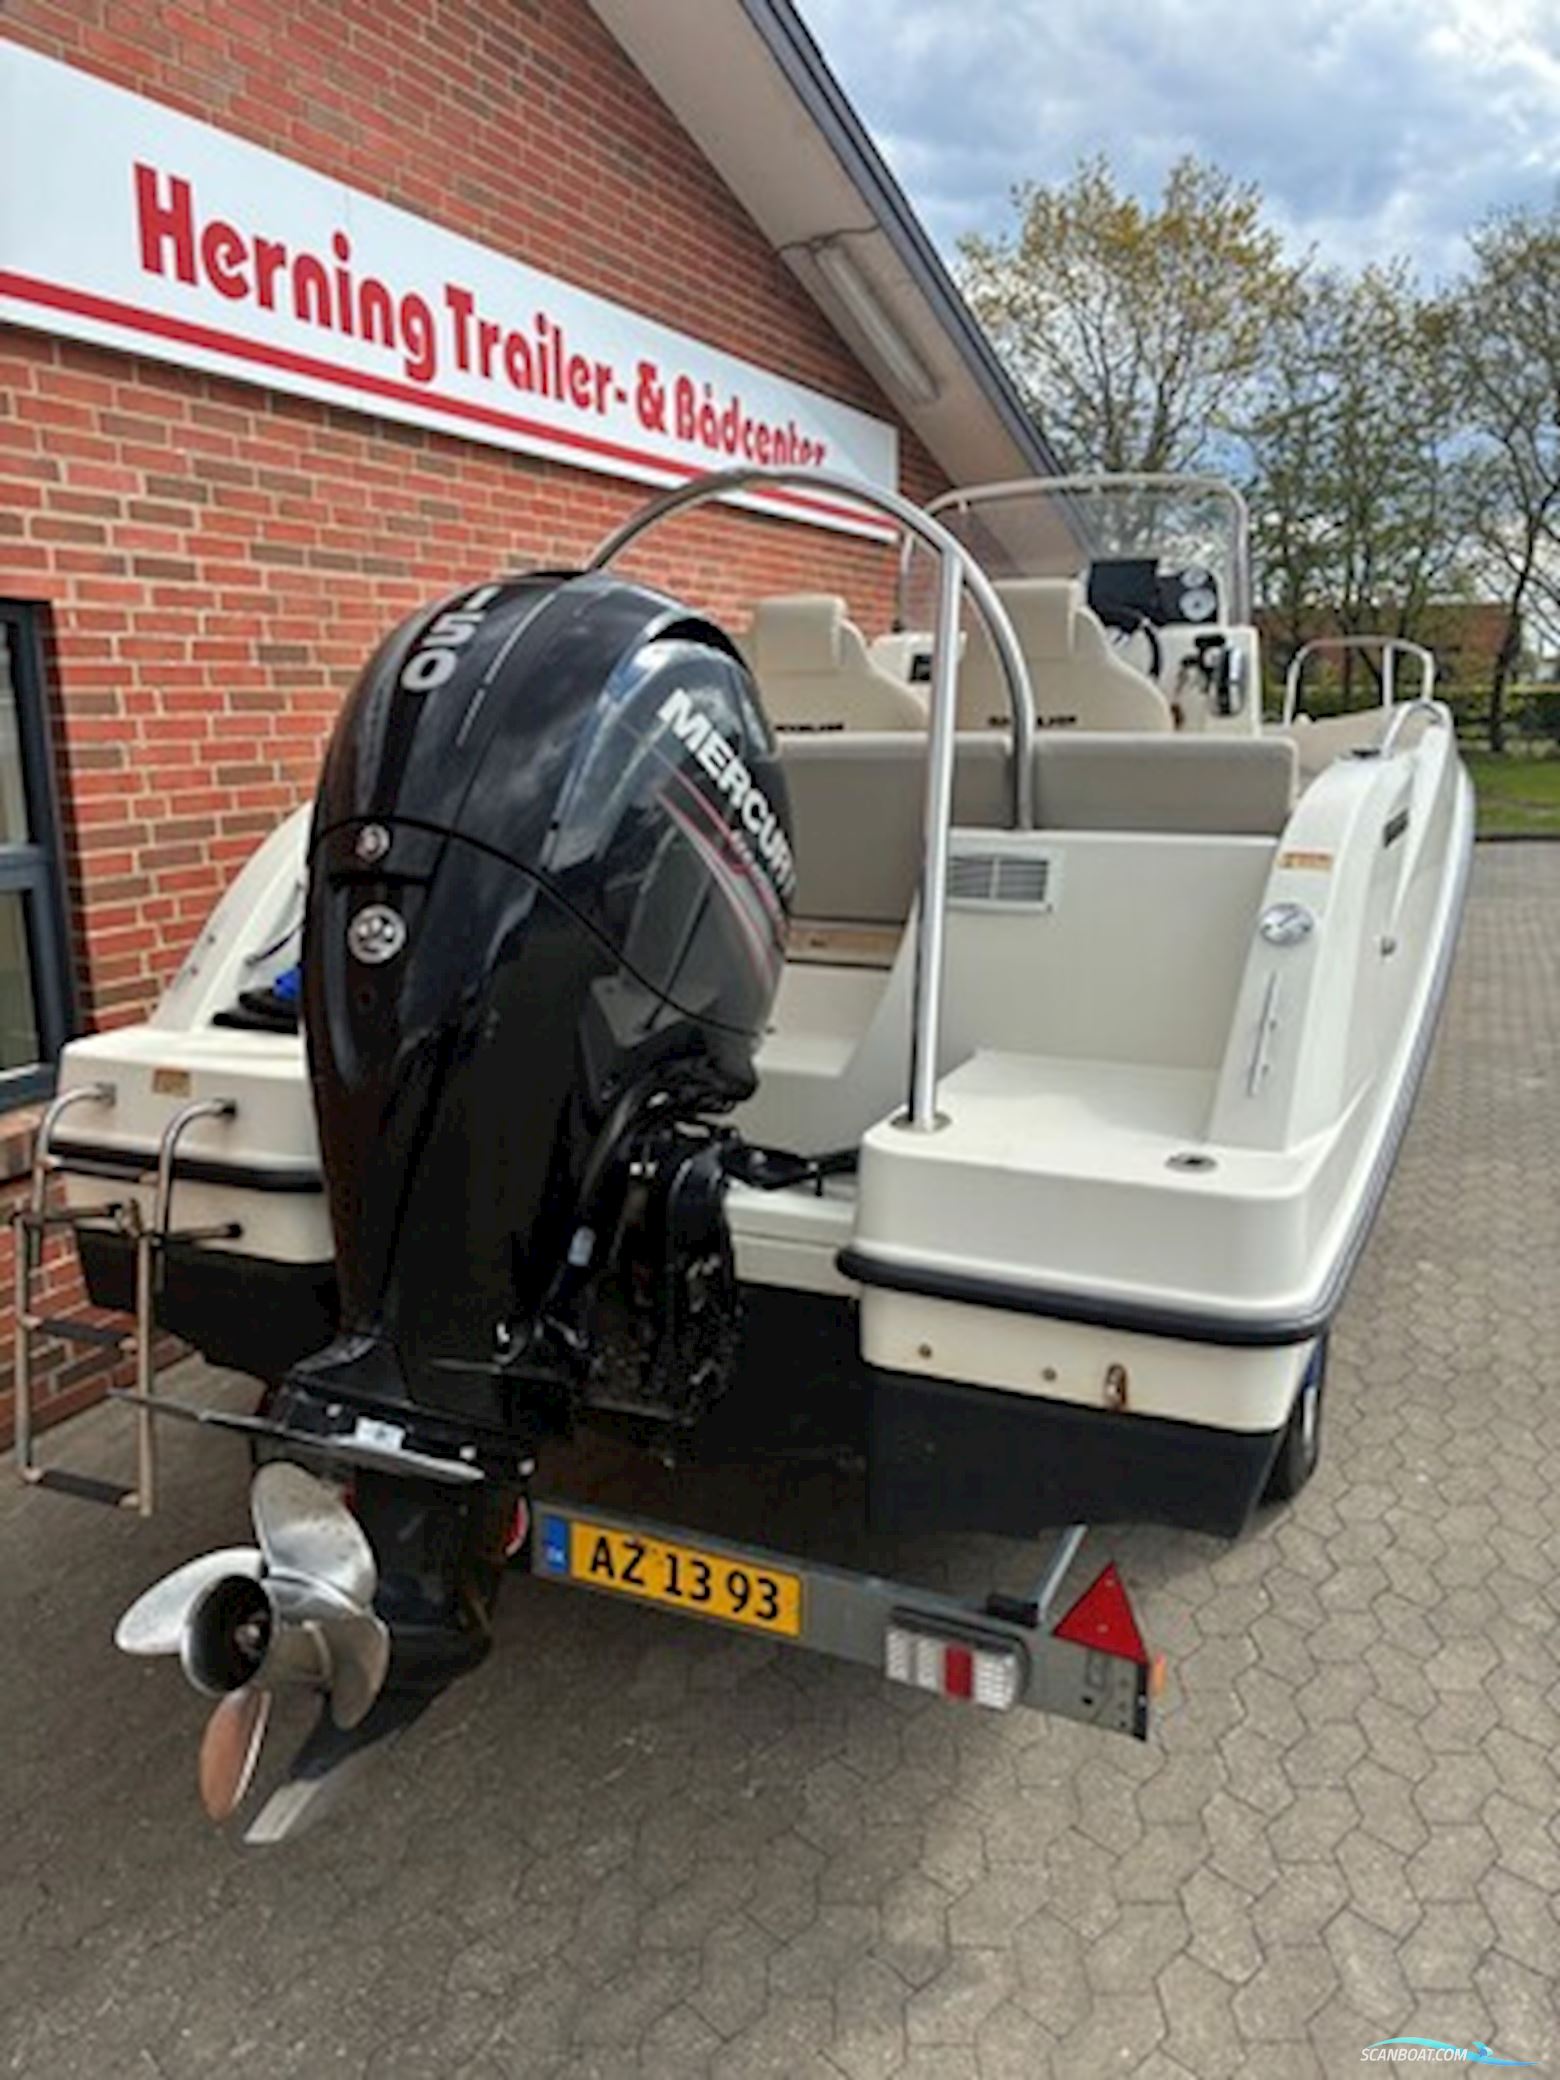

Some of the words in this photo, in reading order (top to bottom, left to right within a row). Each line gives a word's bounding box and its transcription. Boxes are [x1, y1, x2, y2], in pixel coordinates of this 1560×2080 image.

[133, 161, 436, 383] Herning
[443, 283, 626, 414] Trailer-
[636, 361, 666, 434] &
[401, 586, 500, 691] 150
[589, 1536, 645, 1586] AZ
[664, 1553, 711, 1601] 13
[726, 1571, 778, 1620] 93
